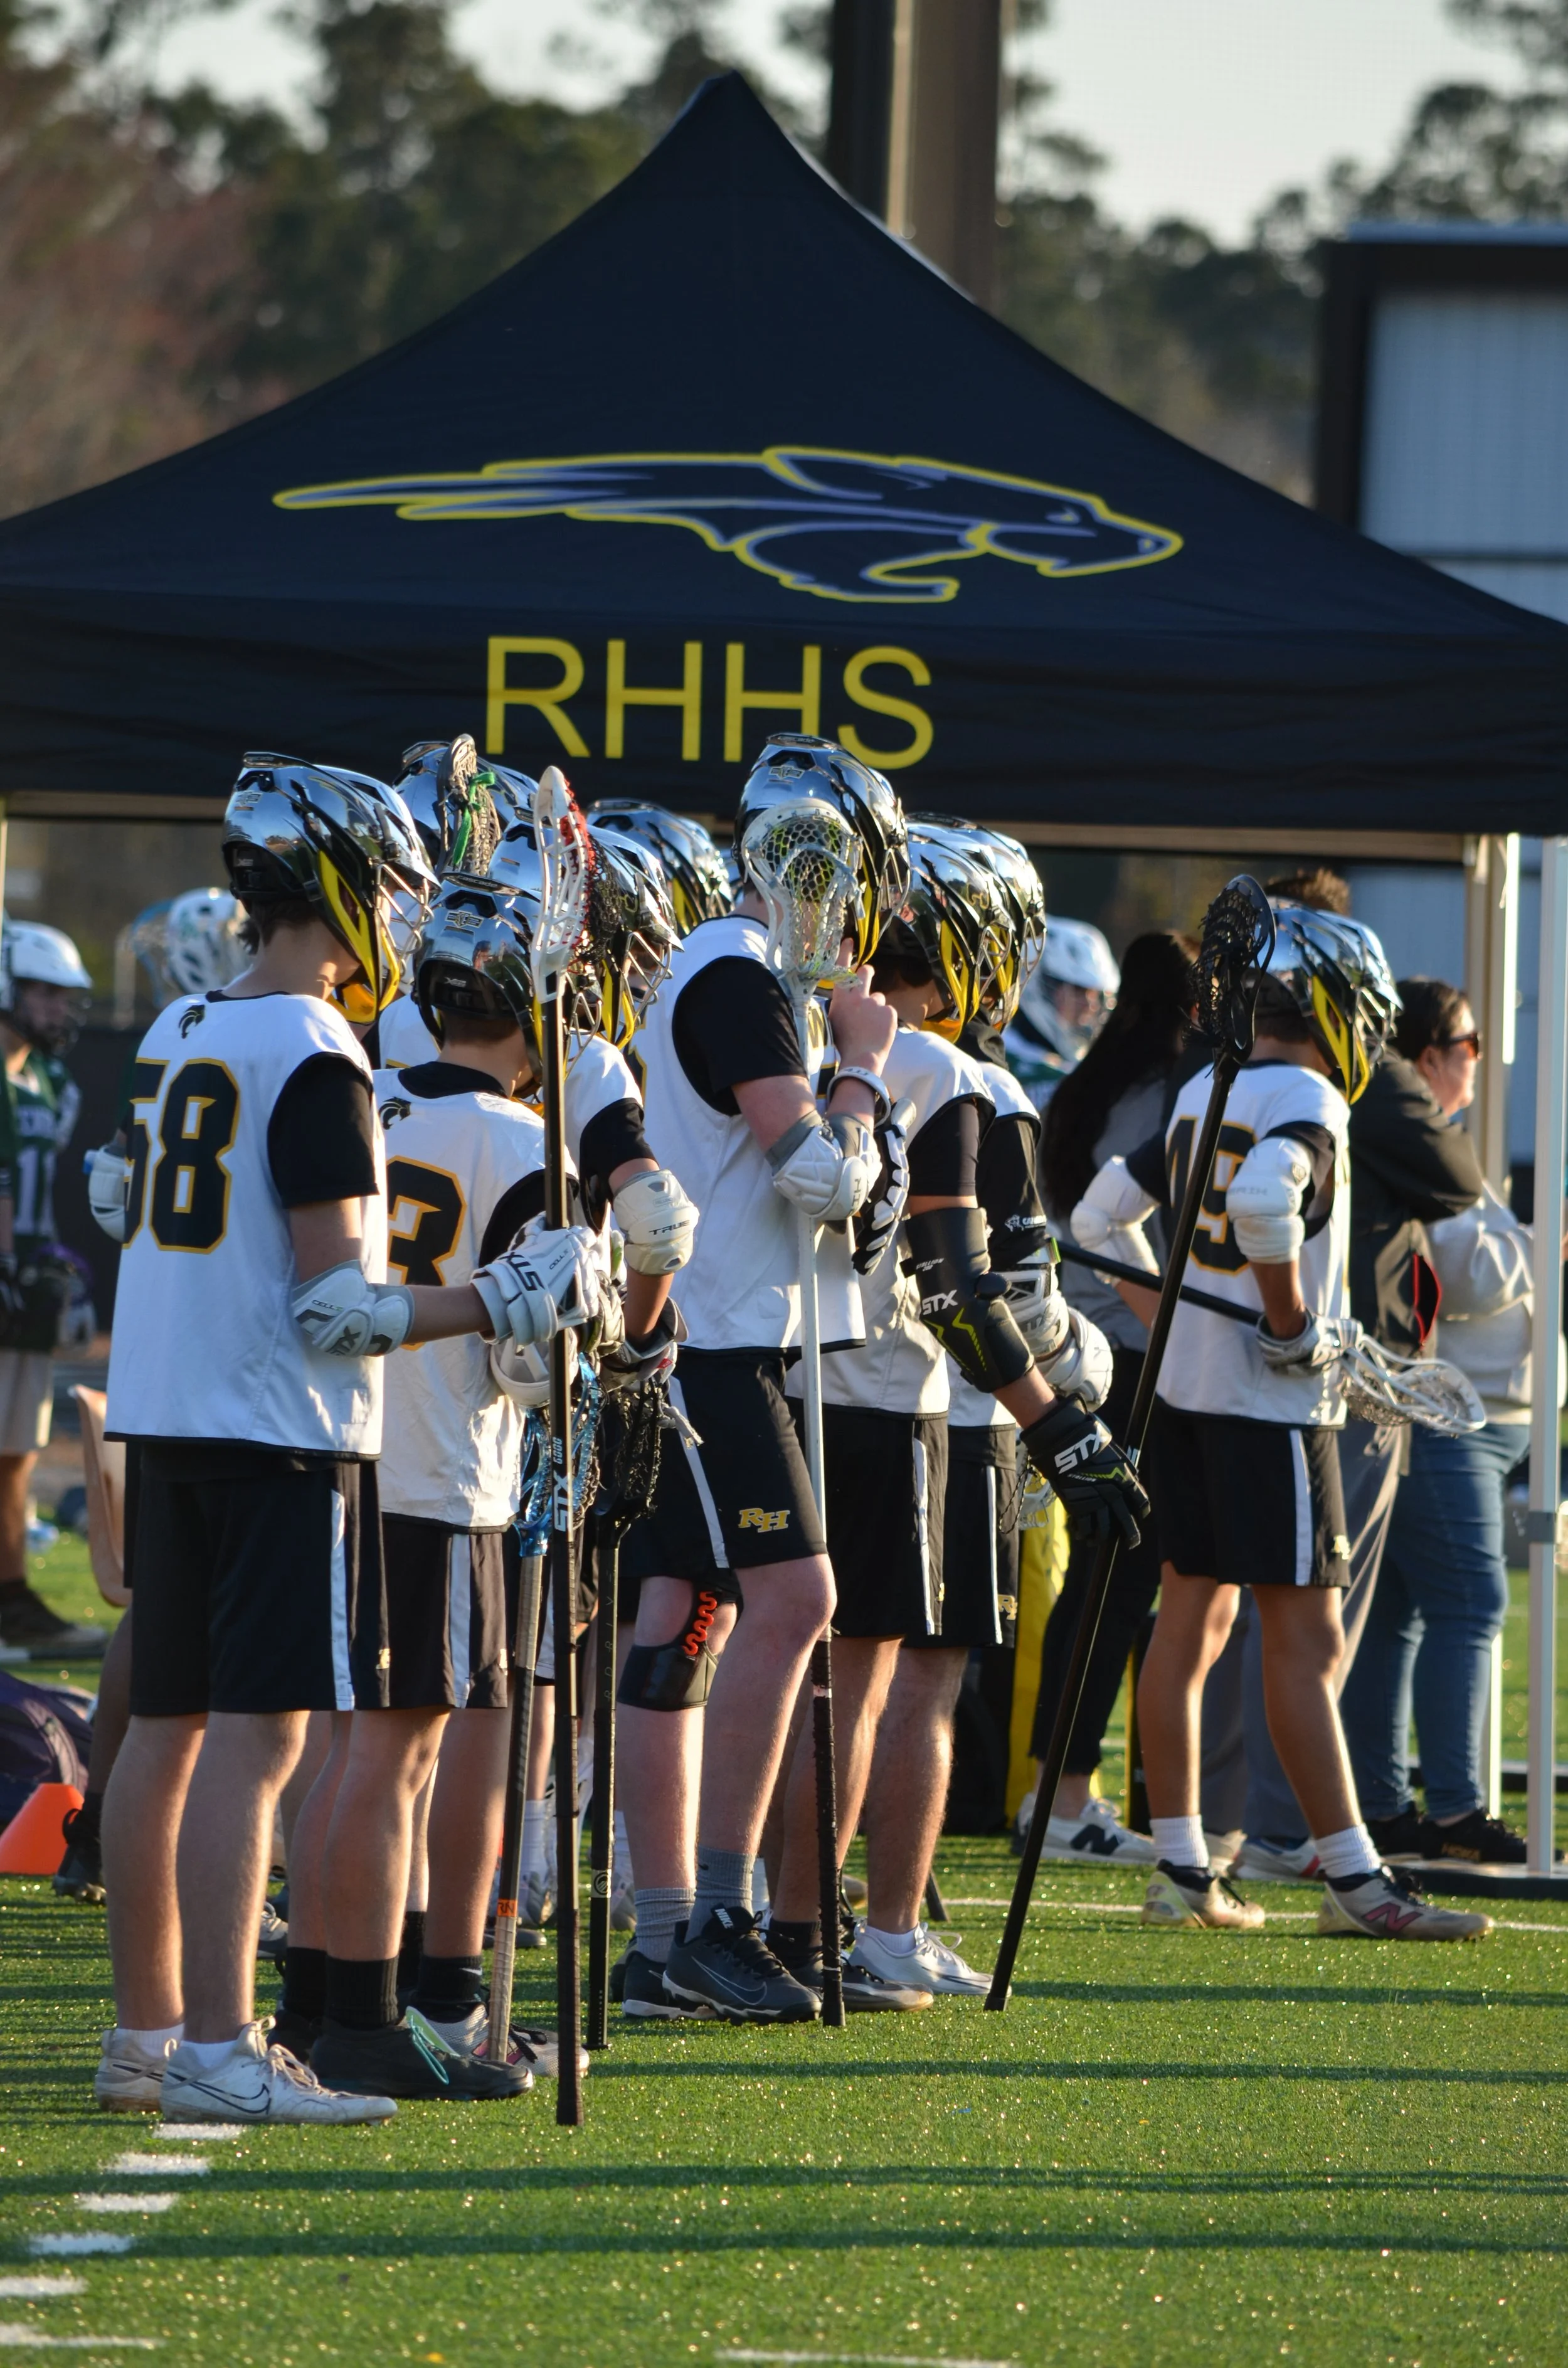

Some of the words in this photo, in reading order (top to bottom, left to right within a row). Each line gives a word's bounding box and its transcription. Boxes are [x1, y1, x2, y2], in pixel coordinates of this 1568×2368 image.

[486, 635, 934, 770] RHHS
[457, 874, 498, 888] cascade
[122, 1057, 241, 1255] 58
[649, 1219, 691, 1236] TRUE
[499, 1251, 546, 1292] STX
[921, 1289, 958, 1315] STX
[553, 1436, 563, 1465] 6000
[1054, 1425, 1106, 1474] STX
[553, 1470, 571, 1532] STX
[738, 1507, 790, 1533] RH
[714, 1908, 734, 1929] NIKE
